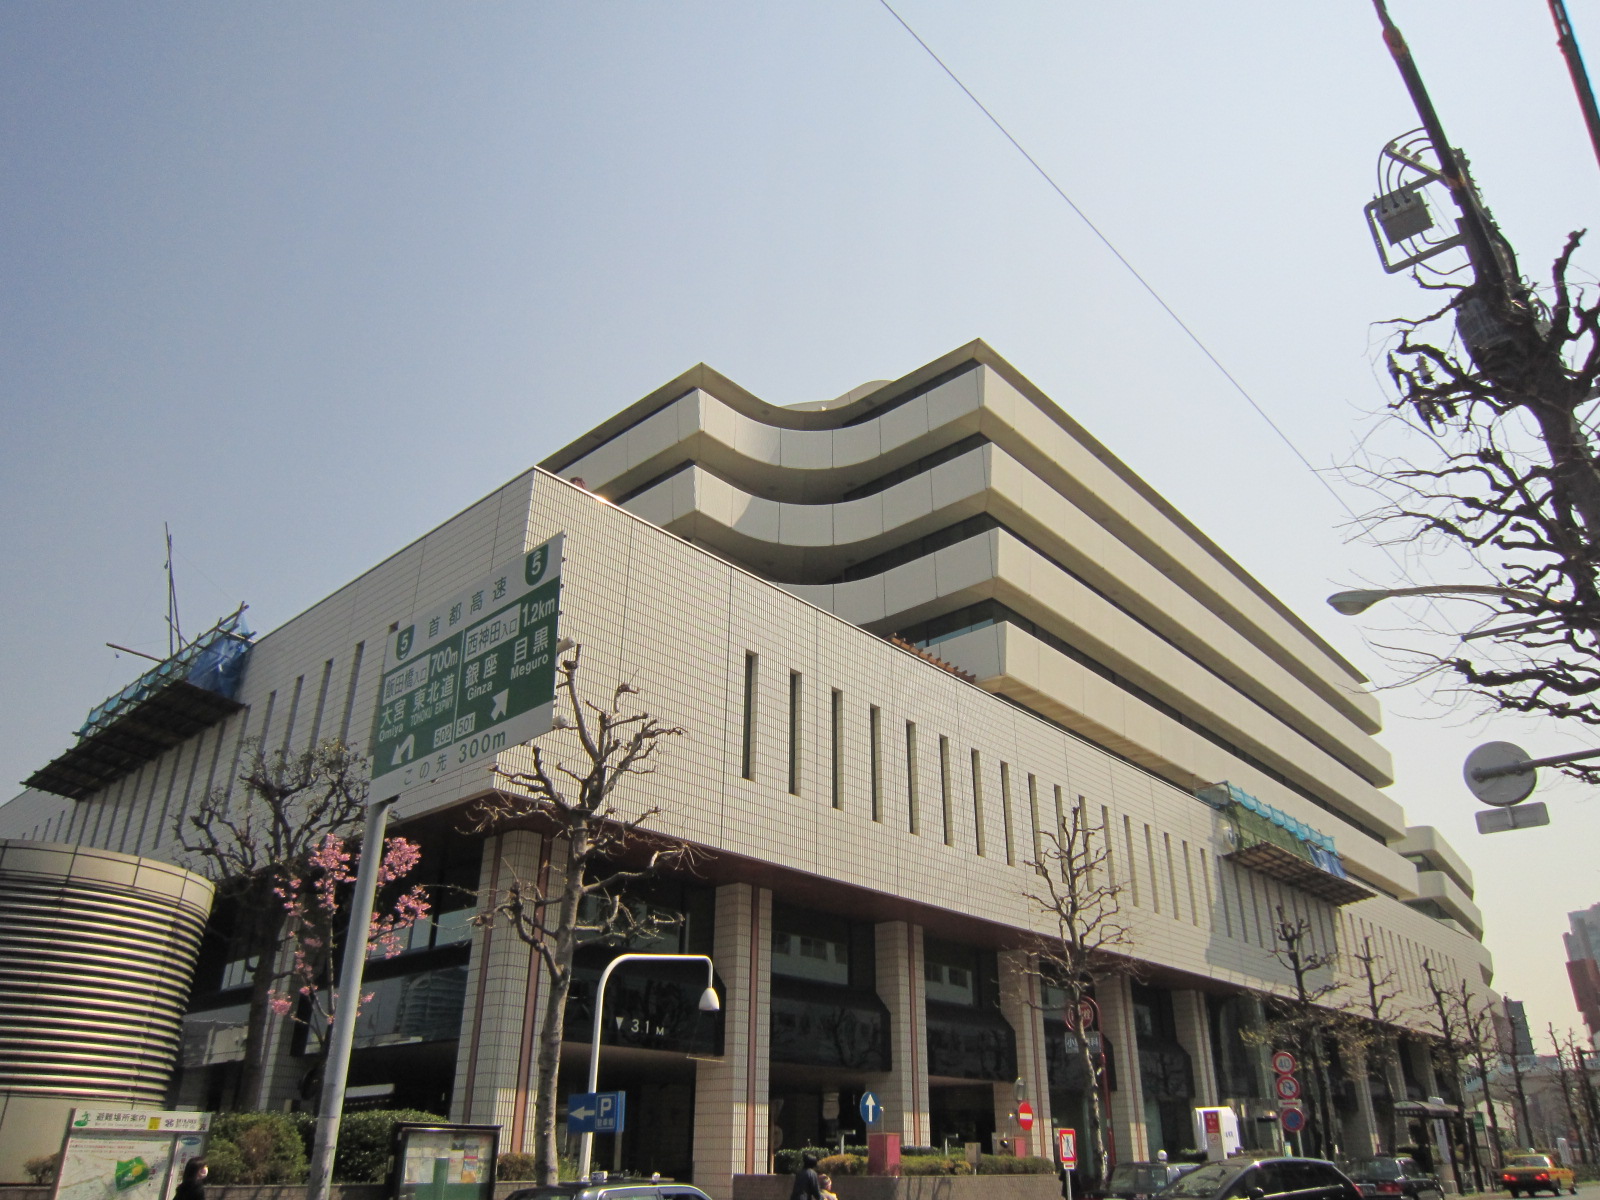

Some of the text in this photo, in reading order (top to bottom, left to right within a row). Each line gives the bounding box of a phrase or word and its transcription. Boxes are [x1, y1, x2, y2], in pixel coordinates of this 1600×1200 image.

[400, 555, 541, 651] 5 首都高速 5
[467, 597, 555, 657] 西神田入口 1.2km
[465, 626, 549, 688] 銀座 目黒
[385, 646, 459, 699] 飯田橋入口 700m
[467, 654, 549, 701] Ginza Meguro
[380, 673, 455, 729] 大宮 東北道
[410, 706, 433, 726] TOHOKU
[458, 715, 474, 736] 501
[379, 723, 404, 742] Omiya
[435, 726, 451, 745] 502
[404, 730, 506, 785] この先 300m
[630, 1018, 665, 1036] 3.1 M
[1278, 1058, 1290, 1069] 40
[96, 1112, 147, 1122] 避難場所案内
[600, 1098, 612, 1117] P
